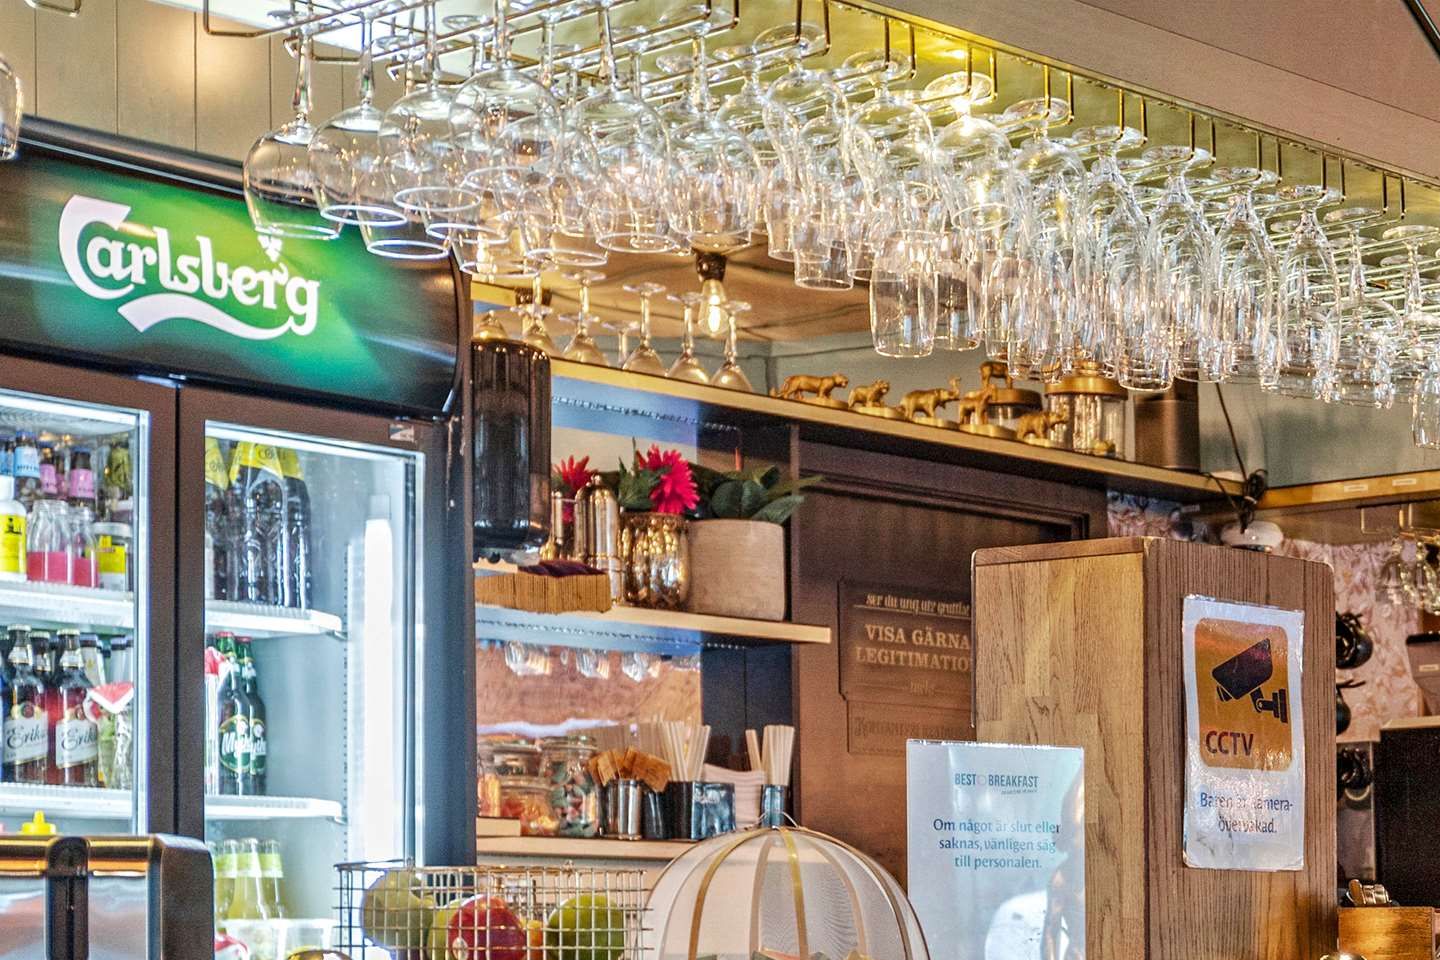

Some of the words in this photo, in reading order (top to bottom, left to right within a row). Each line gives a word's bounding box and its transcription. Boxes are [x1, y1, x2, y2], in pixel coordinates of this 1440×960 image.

[59, 194, 320, 338] Carlsberg
[864, 623, 906, 644] VISA
[912, 627, 971, 650] GÄRNA
[855, 646, 970, 673] LEGITIMATIO
[1205, 730, 1254, 756] CCTV
[954, 773, 976, 786] BEST
[988, 774, 1039, 788] BREAKFAST
[933, 818, 955, 831] Om
[959, 819, 993, 835] något
[995, 820, 1007, 833] är
[1011, 820, 1032, 833] slut
[1034, 821, 1061, 833] eller
[939, 837, 983, 852] saknas,
[984, 838, 1035, 854] vänligen
[1036, 839, 1057, 854] säg
[954, 856, 971, 868] till
[974, 856, 1042, 870] personalen.
